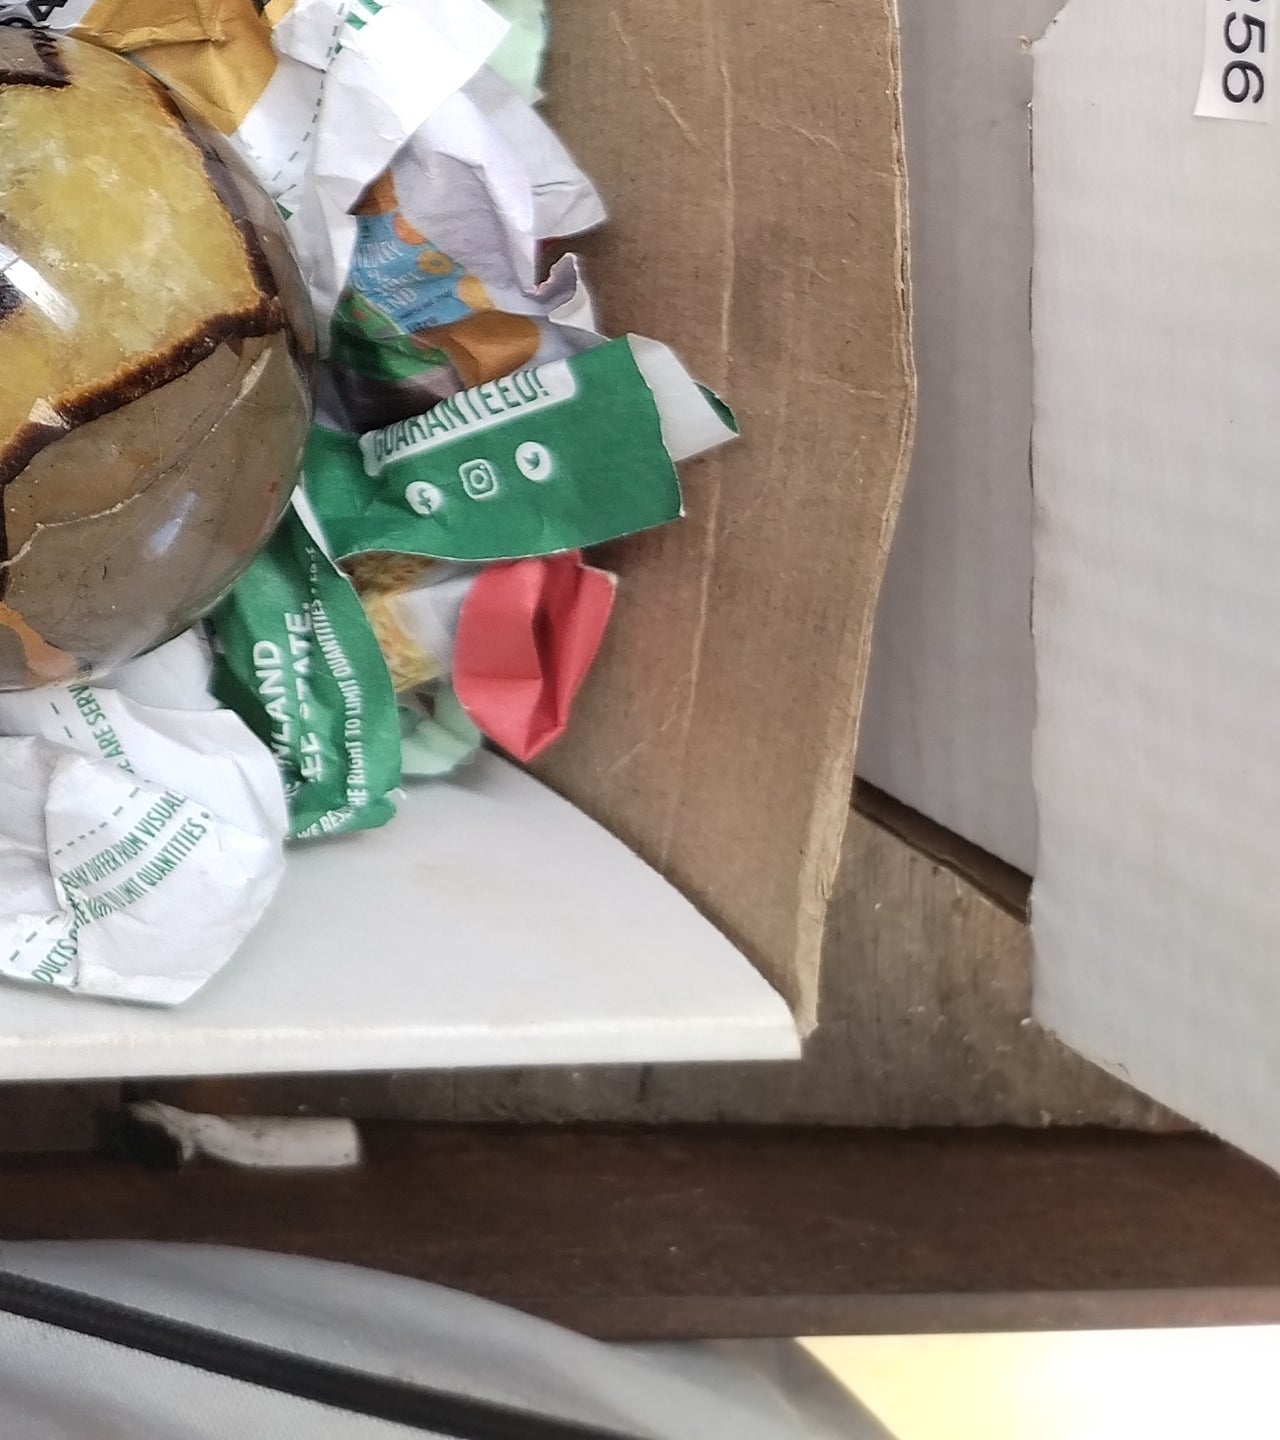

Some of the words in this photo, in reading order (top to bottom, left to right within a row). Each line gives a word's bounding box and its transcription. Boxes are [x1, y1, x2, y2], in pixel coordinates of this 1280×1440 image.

[311, 598, 353, 677] QUANTITIES
[339, 679, 365, 717] LIMIT
[92, 723, 125, 760] ARE
[344, 717, 364, 736] TO
[345, 740, 368, 787] RIGHT
[346, 787, 368, 809] HE
[140, 817, 209, 888] QUANTITIES
